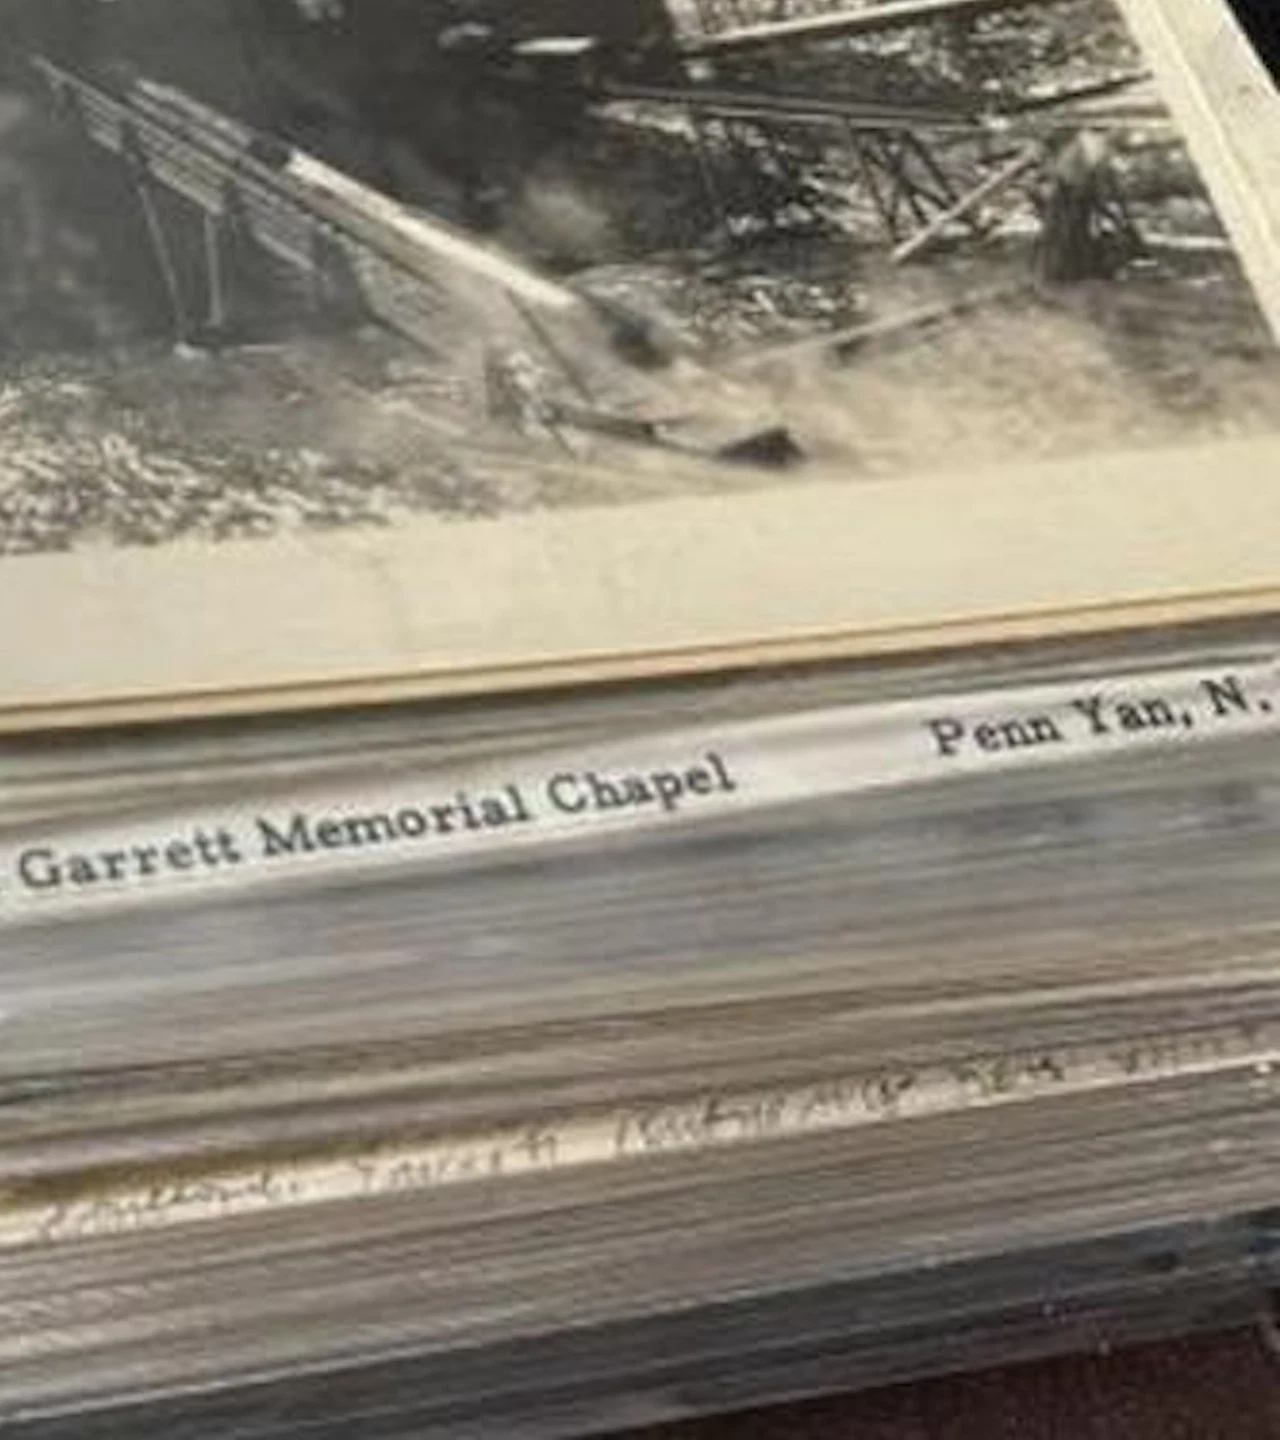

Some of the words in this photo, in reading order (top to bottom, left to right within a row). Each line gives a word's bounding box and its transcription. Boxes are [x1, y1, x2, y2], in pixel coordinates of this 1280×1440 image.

[924, 716, 1064, 757] Penn
[1069, 695, 1194, 735] Yan,
[18, 825, 244, 890] Garrett
[254, 783, 538, 858] Memorial
[546, 753, 737, 811] Chapel
